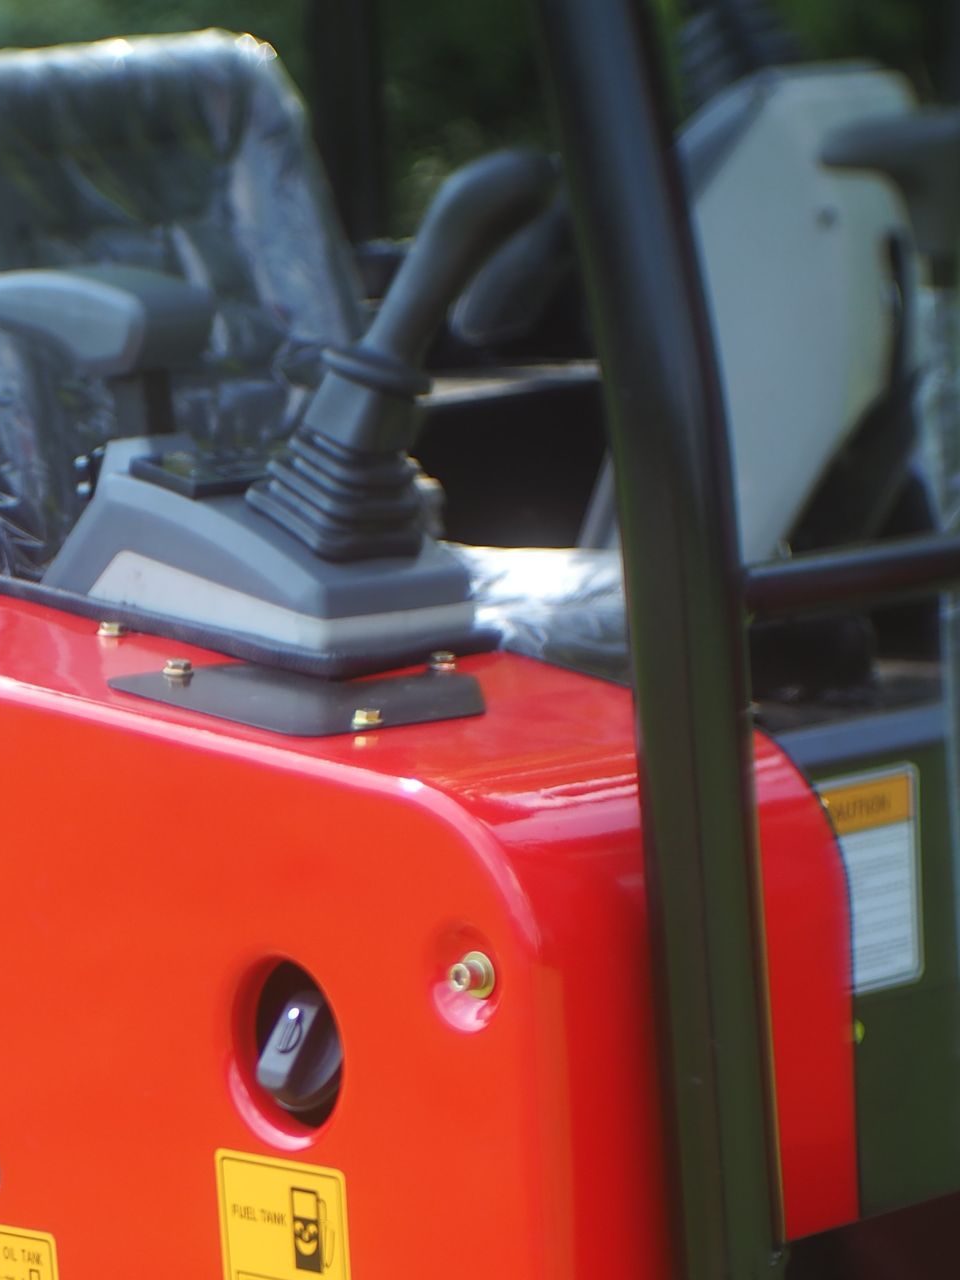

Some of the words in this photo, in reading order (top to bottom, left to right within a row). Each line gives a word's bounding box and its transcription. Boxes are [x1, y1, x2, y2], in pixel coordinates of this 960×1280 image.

[232, 1203, 257, 1222] FUEL
[260, 1208, 287, 1226] TANK
[2, 1245, 18, 1262] OIL
[21, 1249, 44, 1266] TANK
